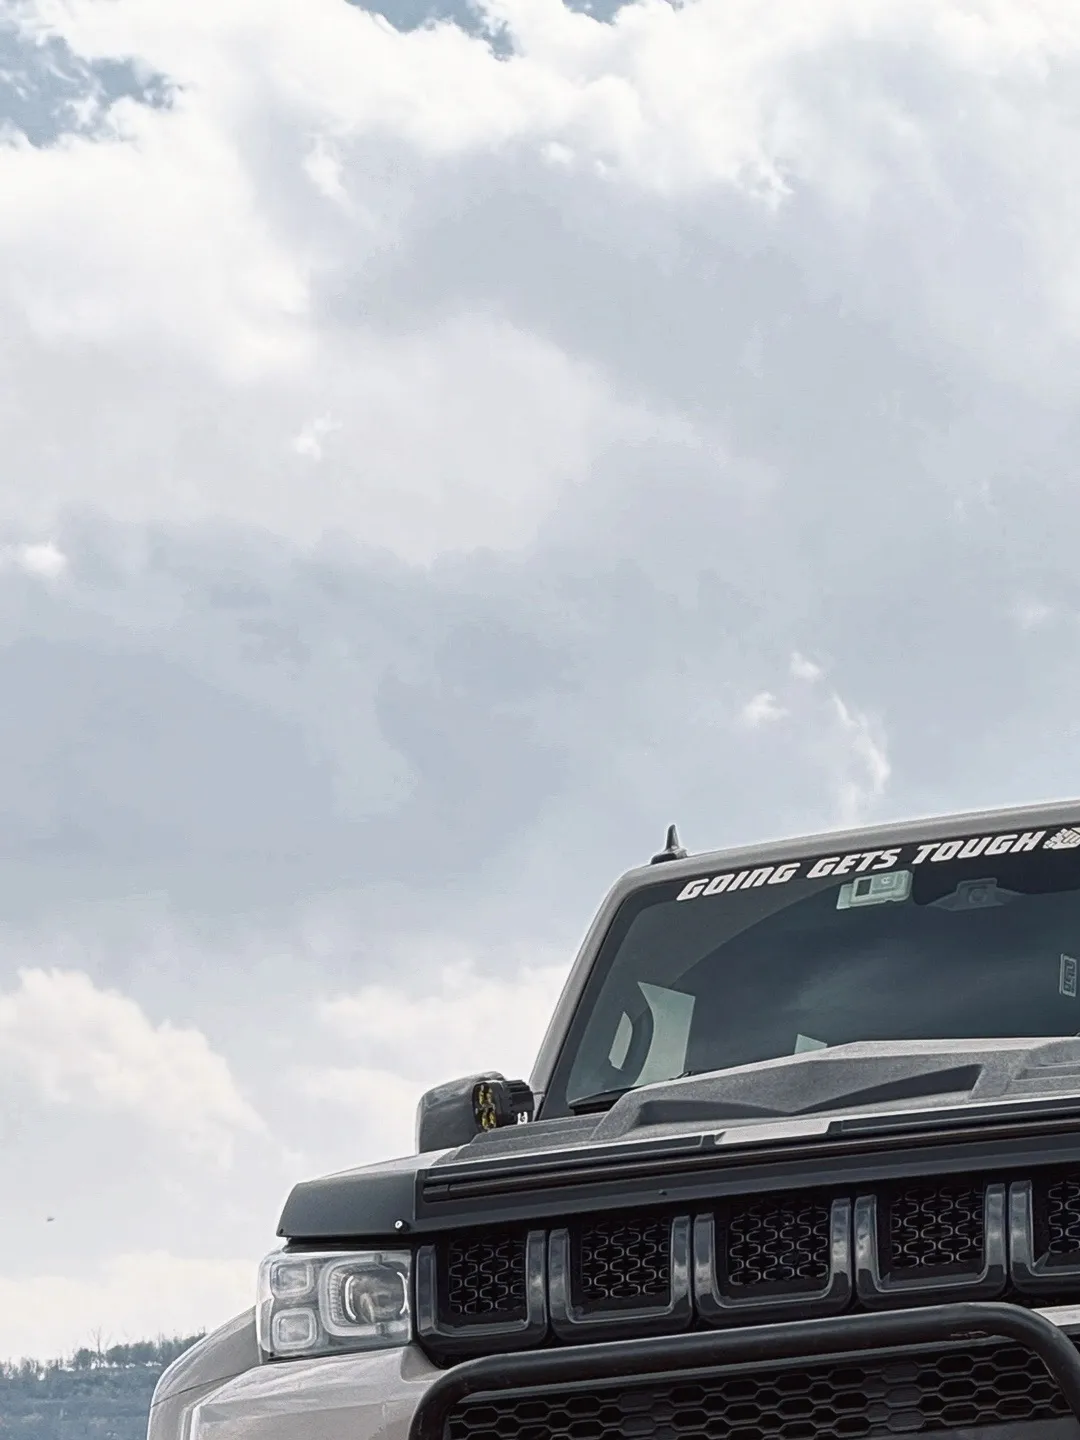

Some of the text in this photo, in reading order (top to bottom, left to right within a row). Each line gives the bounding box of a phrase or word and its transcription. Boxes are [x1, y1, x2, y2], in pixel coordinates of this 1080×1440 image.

[677, 862, 801, 900] GOING
[807, 848, 902, 879] GETS
[912, 831, 1046, 864] TOUGH
